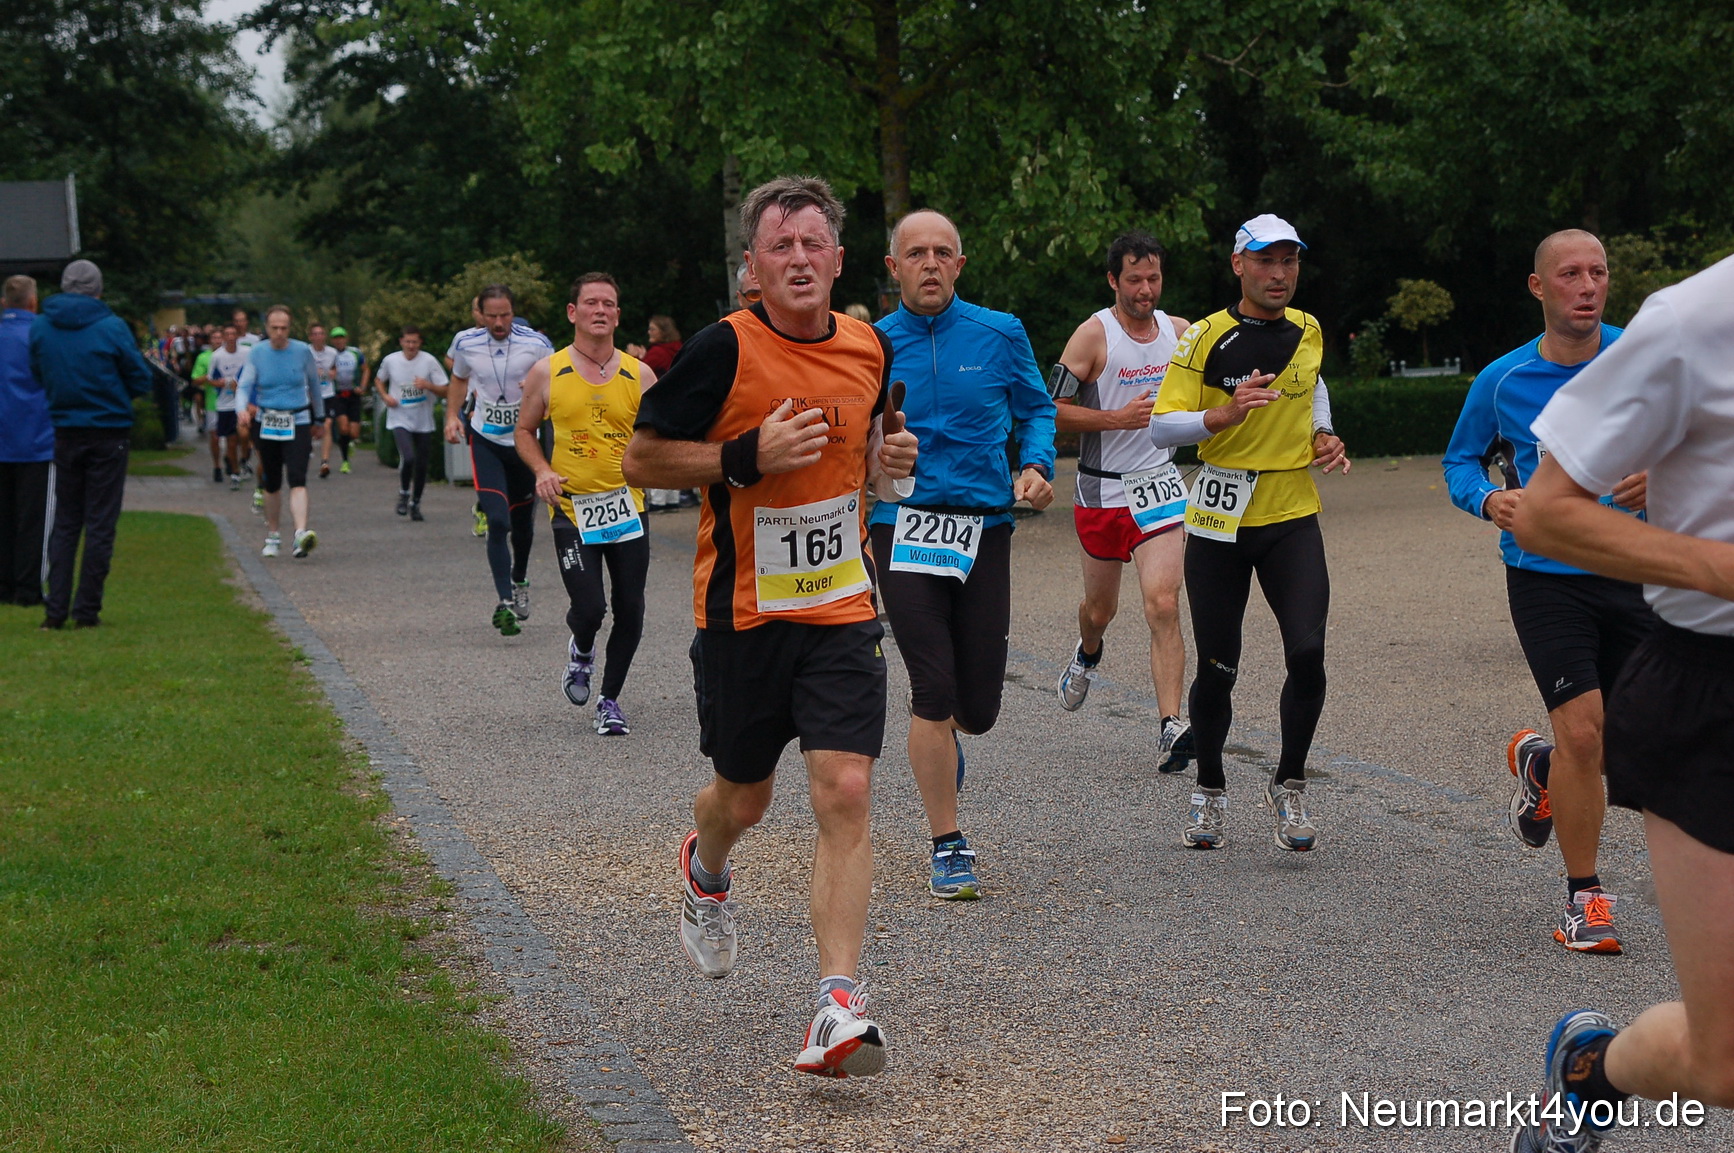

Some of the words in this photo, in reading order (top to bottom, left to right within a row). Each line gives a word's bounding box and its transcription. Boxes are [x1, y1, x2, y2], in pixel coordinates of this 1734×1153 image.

[1223, 374, 1251, 387] Steff
[1124, 477, 1147, 486] PARTL
[1207, 466, 1243, 481] Neumarkt
[574, 498, 594, 506] PARTL
[1132, 477, 1183, 509] 3105
[1197, 476, 1239, 512] 195
[582, 497, 631, 529] 2254
[757, 516, 797, 527] PARTL
[799, 506, 846, 525] Neumarkt
[601, 528, 624, 540] Klaus
[903, 513, 974, 552] 2204
[780, 521, 843, 568] 165
[909, 549, 960, 568] Wolfgang
[795, 575, 834, 594] Xaver
